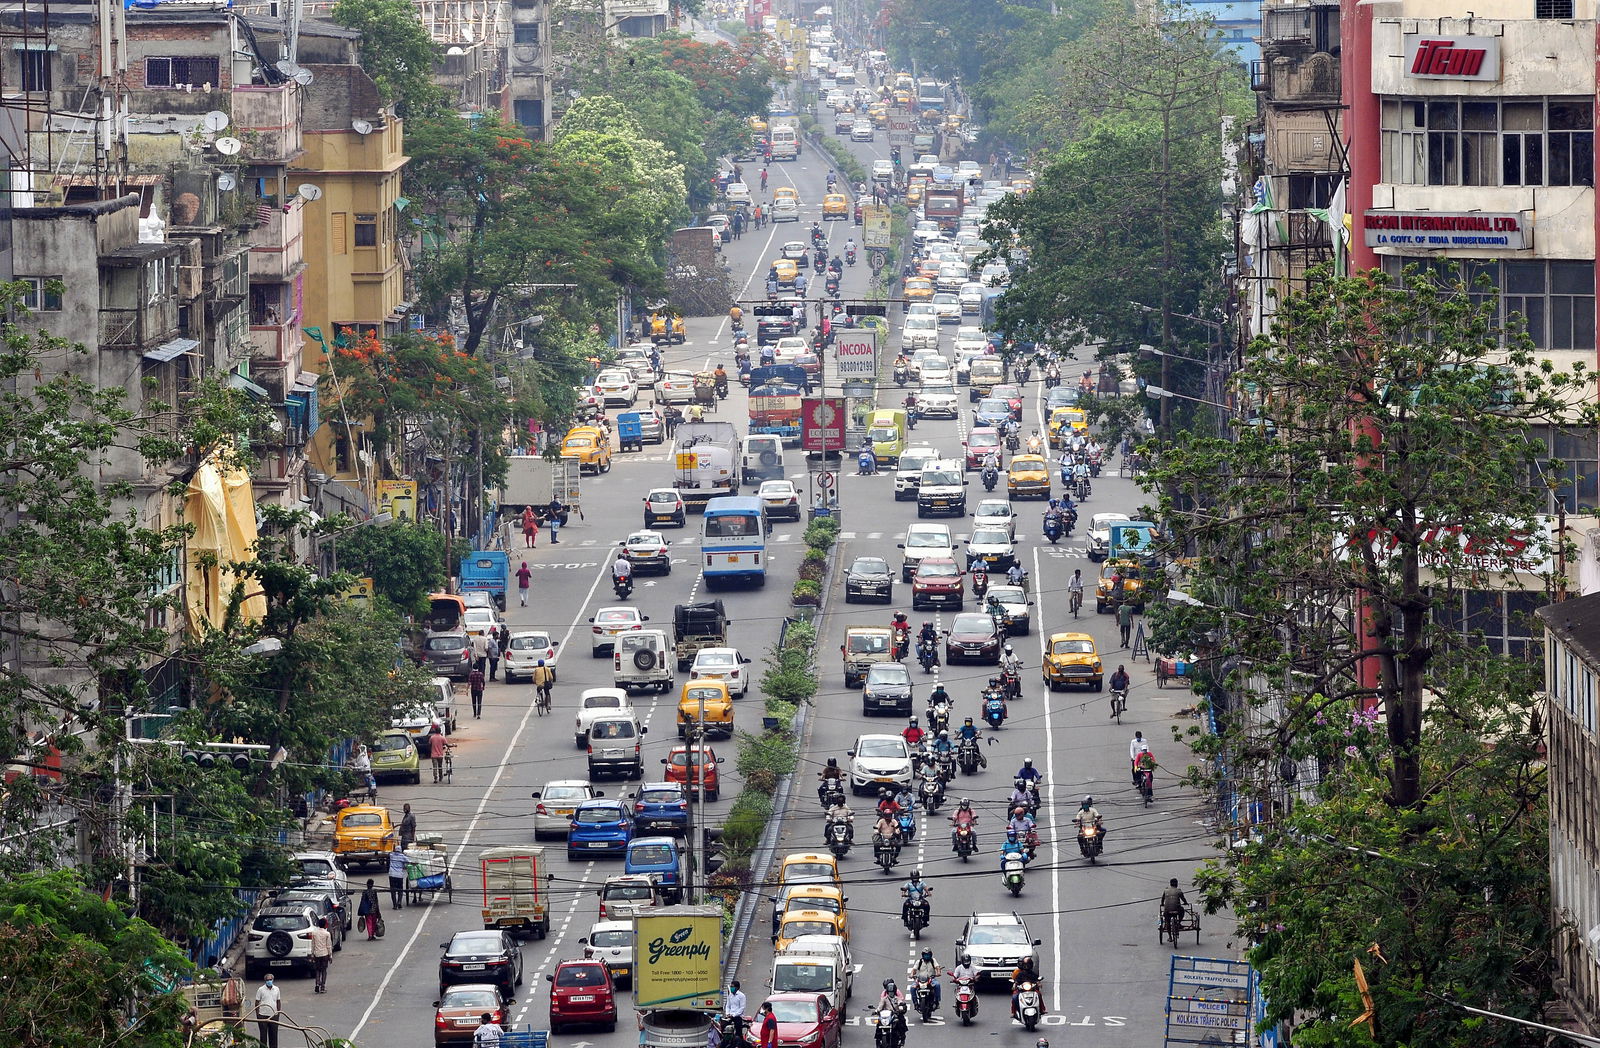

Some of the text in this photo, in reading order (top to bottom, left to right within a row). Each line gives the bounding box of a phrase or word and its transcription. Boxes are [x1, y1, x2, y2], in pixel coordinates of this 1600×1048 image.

[1415, 236, 1426, 244] OF
[1428, 236, 1449, 245] INDIA
[839, 341, 872, 356] INCODA
[648, 937, 711, 965] Greenply
[1177, 1014, 1238, 1027] KOLKATA TRAFFIC POLICE
